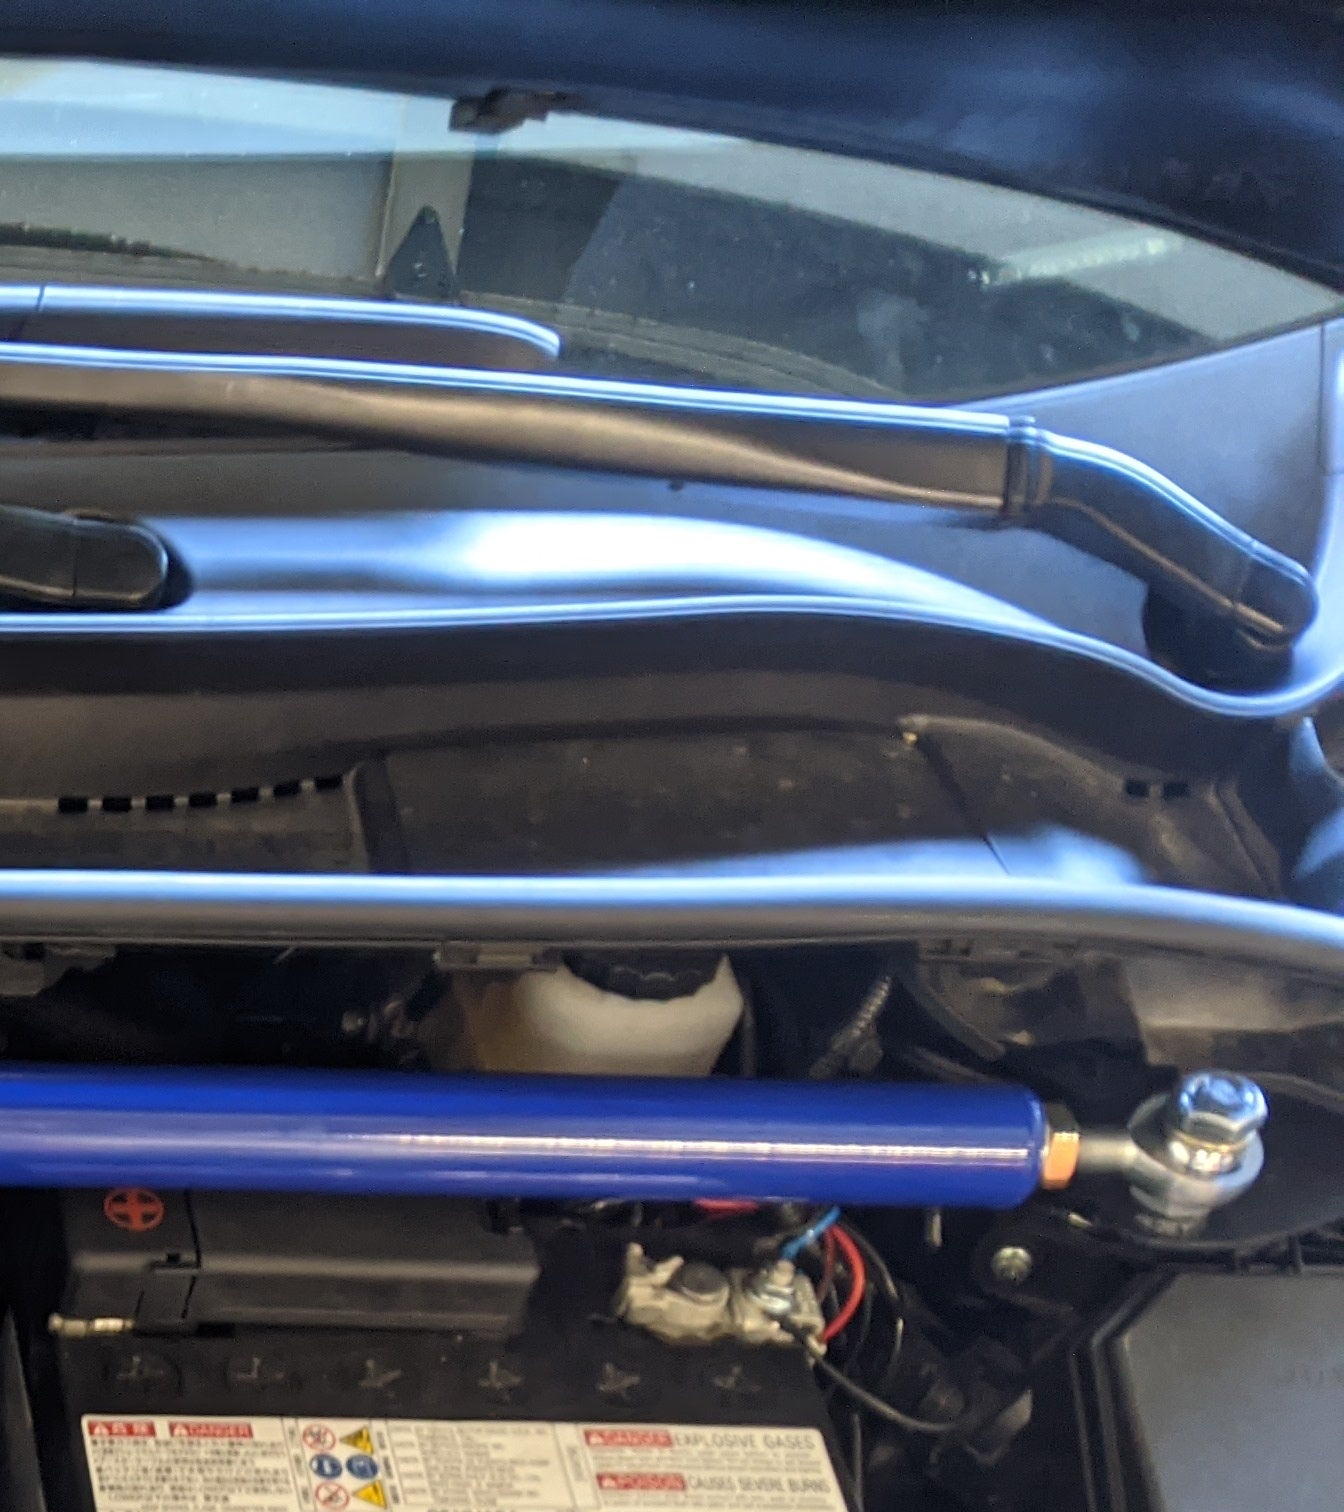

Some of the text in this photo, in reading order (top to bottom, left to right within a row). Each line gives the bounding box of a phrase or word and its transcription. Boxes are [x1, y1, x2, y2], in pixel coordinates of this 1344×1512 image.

[189, 1423, 252, 1437] DANGER
[675, 1433, 815, 1450] EXPLOSIVE GASES
